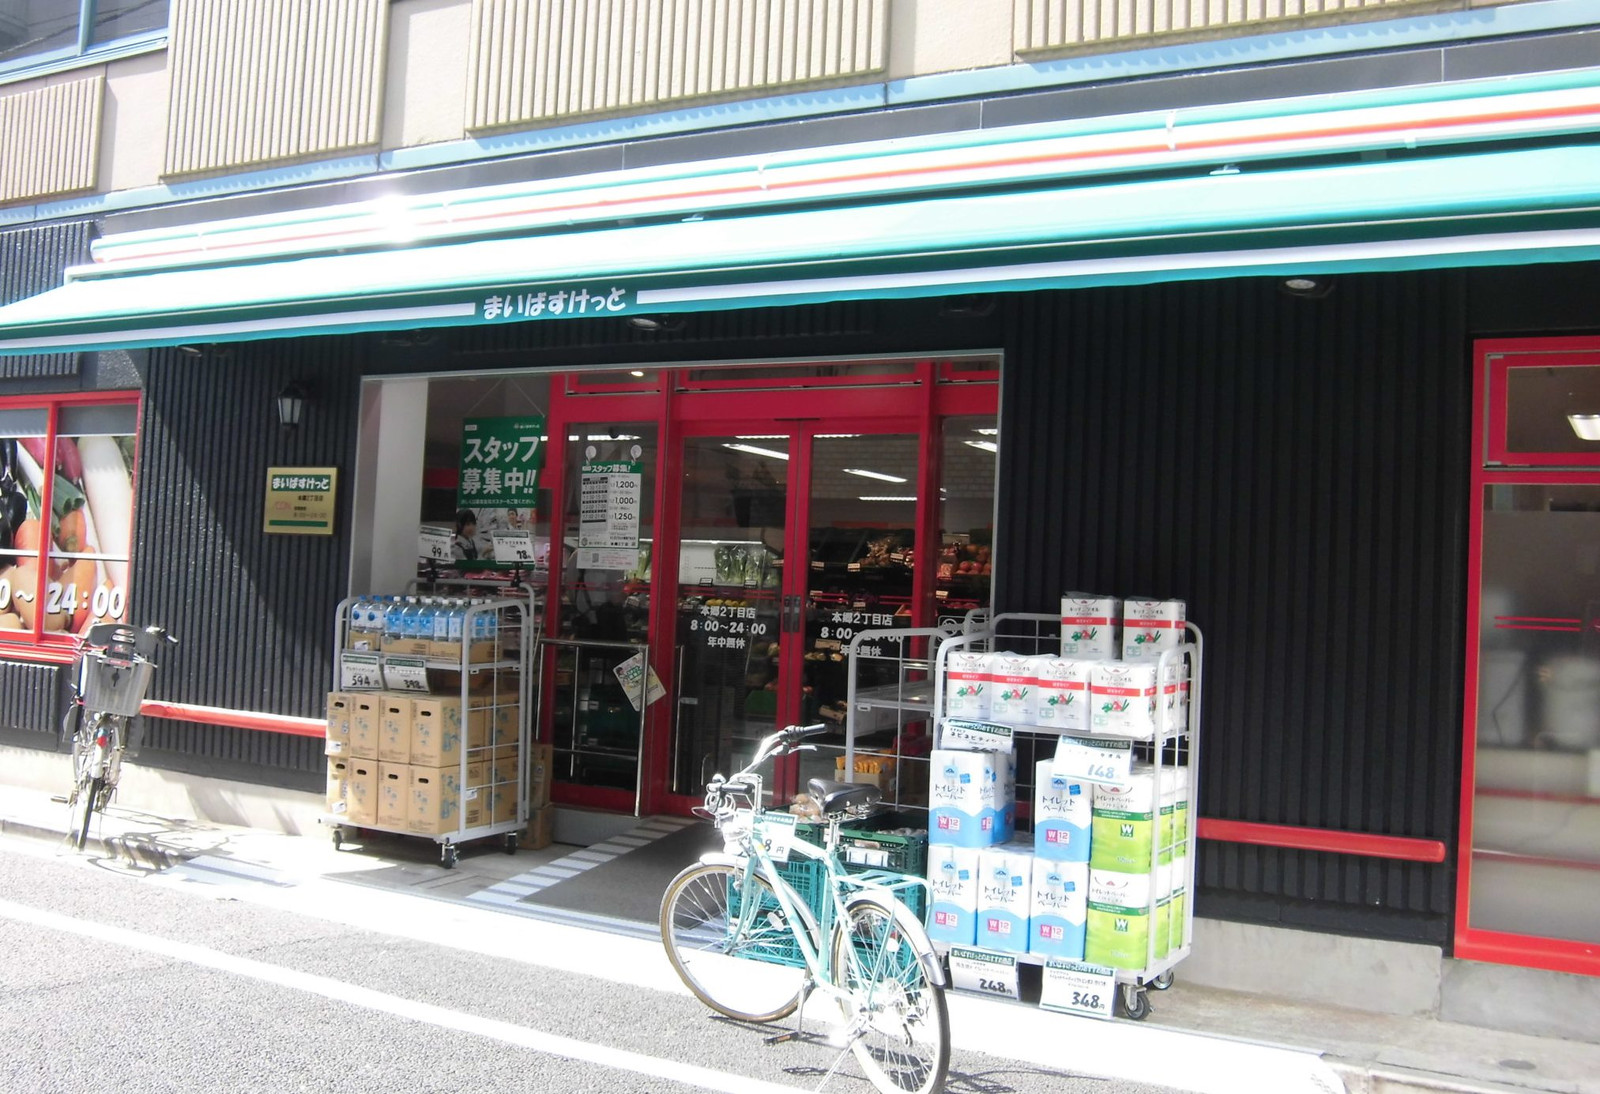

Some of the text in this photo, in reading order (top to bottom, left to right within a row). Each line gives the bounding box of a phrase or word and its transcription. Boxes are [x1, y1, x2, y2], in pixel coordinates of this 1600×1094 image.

[483, 287, 626, 320] まいばすけっと
[464, 436, 539, 464] スタッフ
[272, 477, 329, 490] まいばすけっと
[462, 467, 536, 494] 募集中!!
[615, 481, 634, 489] 1,200
[615, 497, 634, 505] 1,000
[614, 513, 633, 521] 1,250
[700, 606, 756, 619] 本郷2丁目店
[832, 612, 893, 626] 本郷2丁目店
[707, 636, 746, 649] 年中無休
